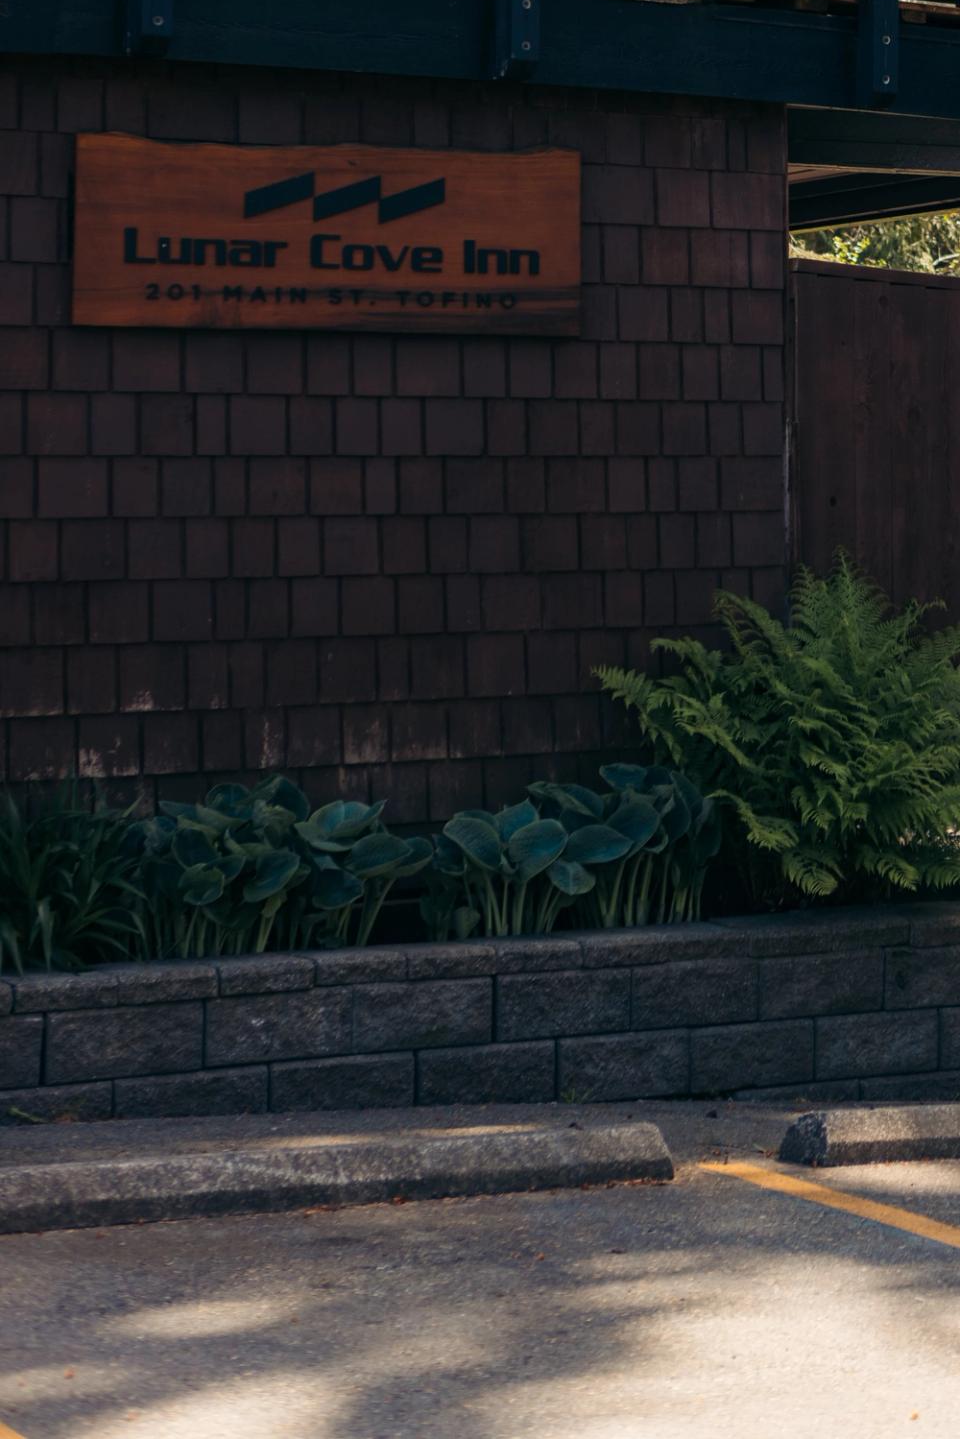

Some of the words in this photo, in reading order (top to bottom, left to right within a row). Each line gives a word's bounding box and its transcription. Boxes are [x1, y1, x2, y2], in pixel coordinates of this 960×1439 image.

[123, 227, 288, 267] Lunar
[310, 234, 443, 273] Cove
[463, 240, 541, 275] Inn
[145, 283, 201, 301] 201
[222, 285, 308, 304] MAIN
[328, 288, 376, 306] ST.
[395, 290, 518, 309] TOFINO
